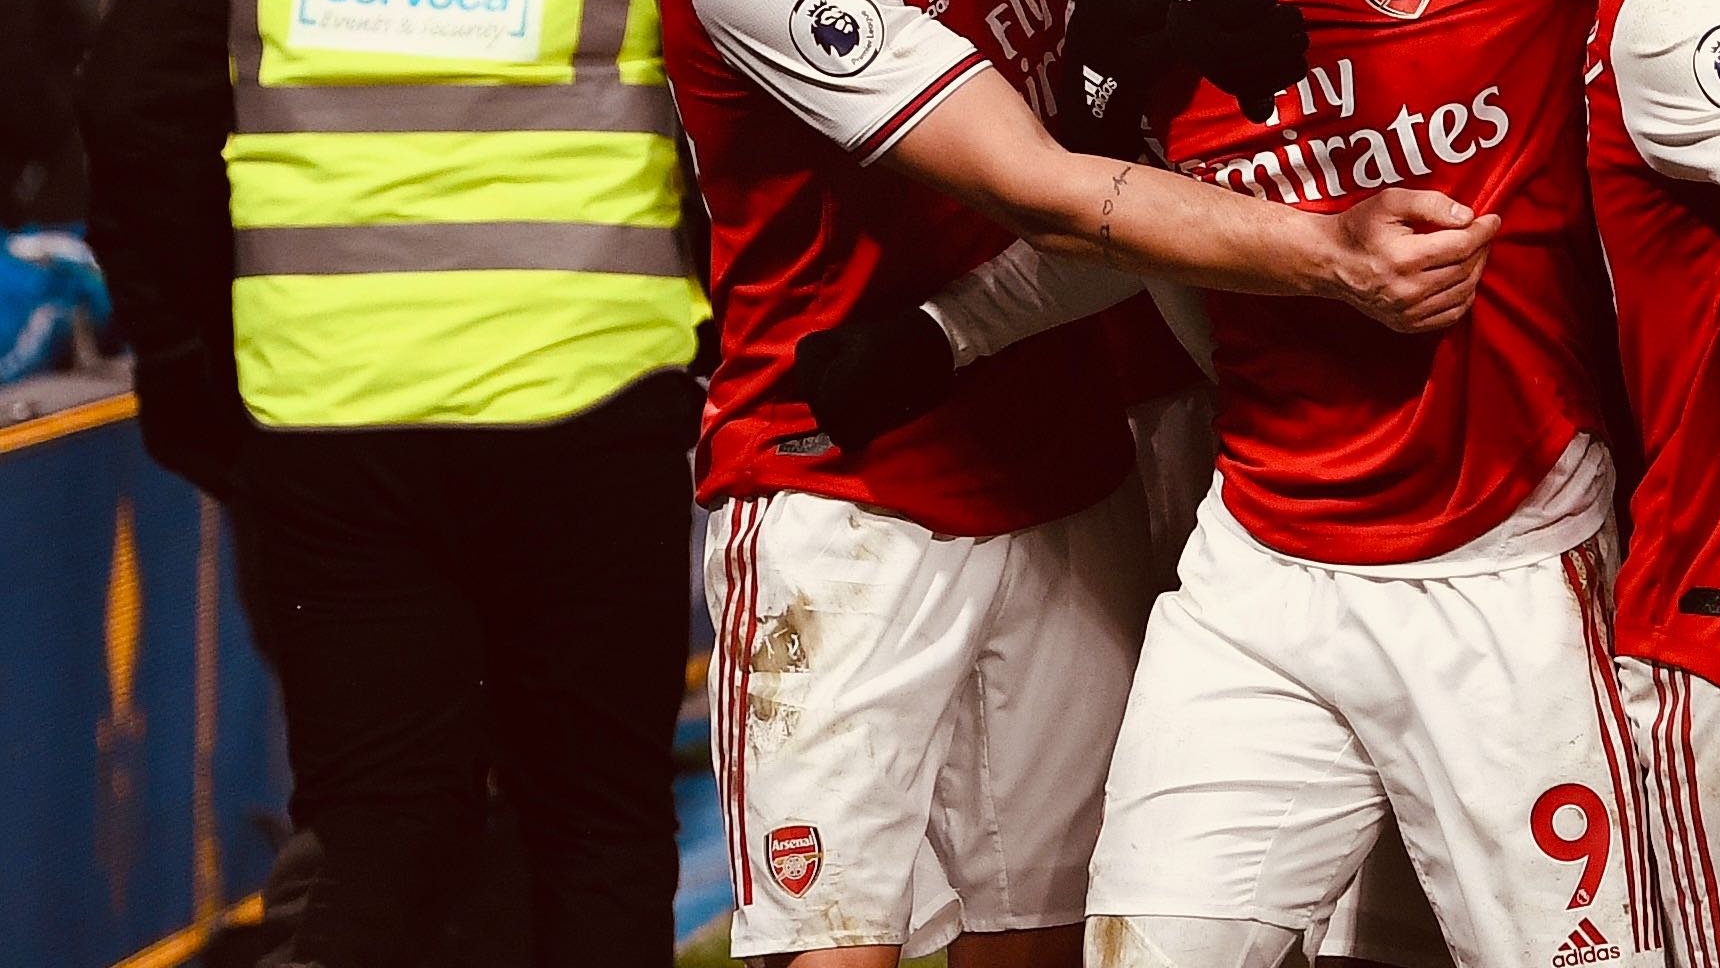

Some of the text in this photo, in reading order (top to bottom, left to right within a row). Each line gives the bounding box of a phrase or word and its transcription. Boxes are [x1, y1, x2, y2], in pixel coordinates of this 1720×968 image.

[1266, 58, 1355, 126] ly
[772, 835, 814, 851] Arsenal
[1530, 783, 1611, 910] 9
[1552, 946, 1621, 968] adidas
